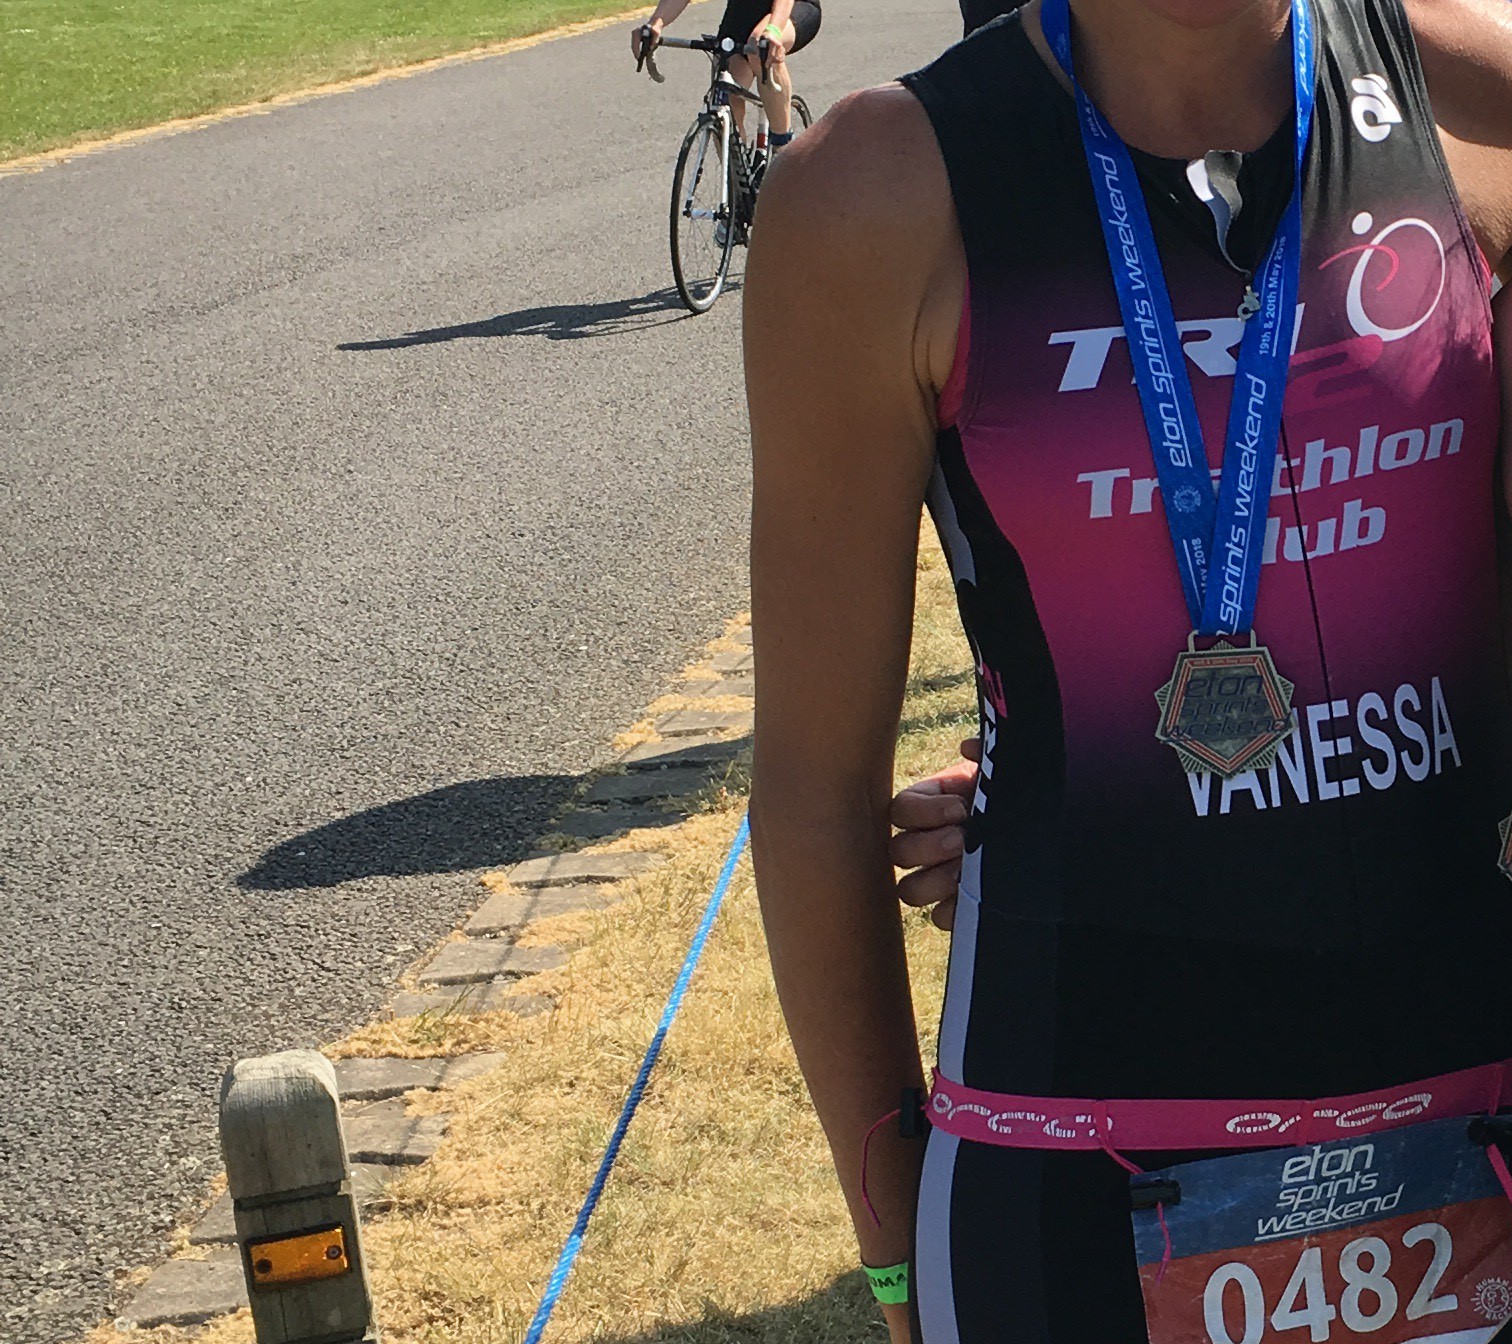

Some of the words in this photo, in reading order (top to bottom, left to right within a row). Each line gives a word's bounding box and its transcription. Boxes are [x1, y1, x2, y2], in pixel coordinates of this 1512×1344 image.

[1093, 151, 1151, 292] weekend
[1268, 263, 1282, 289] May
[1263, 320, 1274, 329] &
[1266, 291, 1277, 318] 20th
[1133, 297, 1175, 394] sprints
[1259, 331, 1272, 355] 19th
[1160, 402, 1188, 468] eton
[1076, 417, 1464, 520] Trthlon
[1220, 525, 1247, 627] sprints
[1234, 372, 1268, 517] weekend
[1191, 537, 1206, 566] 2018
[1260, 498, 1387, 565] lub
[1185, 668, 1265, 699] eton
[1281, 1143, 1375, 1184] eton
[1256, 1182, 1405, 1235] weekend
[1276, 1171, 1379, 1211] sprints
